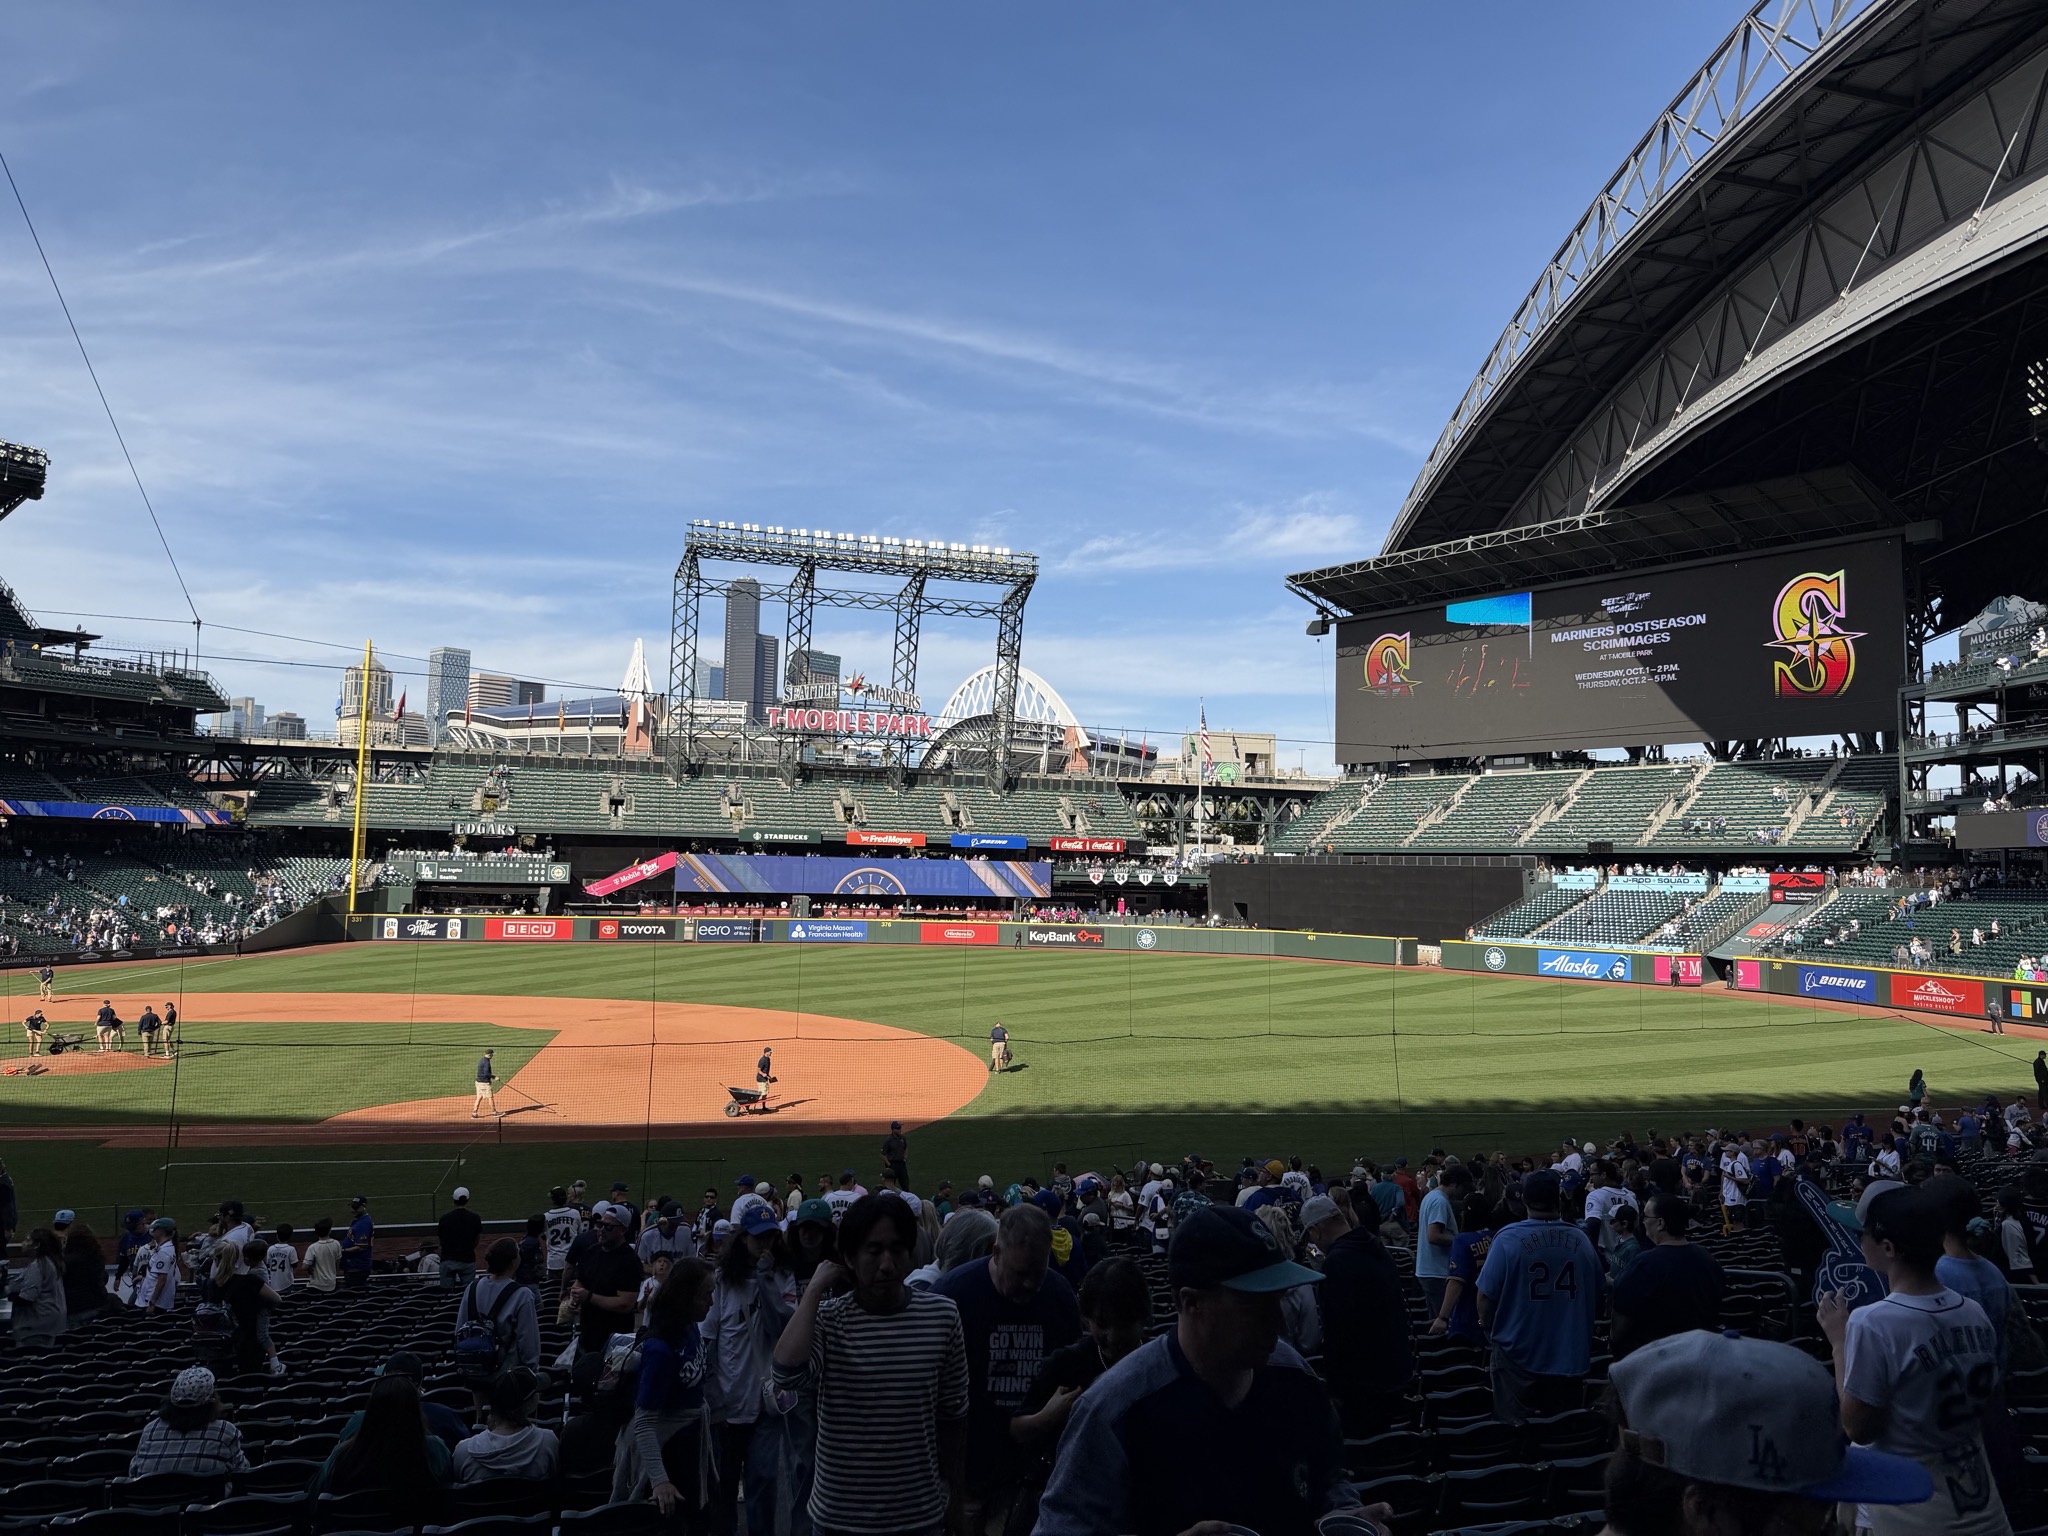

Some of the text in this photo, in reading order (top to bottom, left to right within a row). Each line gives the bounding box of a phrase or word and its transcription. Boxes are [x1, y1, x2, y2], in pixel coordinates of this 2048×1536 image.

[1551, 613, 1706, 643] MARINERS POSTSEASON
[1583, 632, 1671, 652] SCRIMMAGES
[1599, 649, 1653, 661] AT T-MOBILE PARK
[1575, 669, 1626, 681] WEDNESDAY,
[1628, 667, 1645, 676] OCT.
[1657, 665, 1663, 673] 2
[1663, 663, 1680, 672] P.M.
[1578, 679, 1621, 690] THURSDAY,
[1622, 677, 1641, 686] OCT.
[1641, 676, 1647, 684] 2
[1654, 675, 1660, 683] 5
[1660, 673, 1677, 682] P.M.
[784, 684, 837, 702] SEATTLE
[867, 683, 921, 710] MARINERS
[766, 707, 932, 735] T-MOBILE PARK
[870, 835, 912, 845] Fred Meyer
[620, 870, 641, 883] Mobile
[621, 925, 666, 934] TOYOTA
[699, 926, 730, 935] eero
[1029, 931, 1076, 943] KeyBank
[1543, 955, 1599, 976] Alaska
[1819, 976, 1866, 989] BOEING
[1914, 995, 1954, 1005] MUCKLESHOOT
[1922, 1138, 1936, 1151] 44
[548, 1216, 574, 1228] GRIFFEY
[550, 1227, 571, 1245] 24
[1520, 1229, 1582, 1255] GRIFFEY
[271, 1259, 286, 1272] 24
[1528, 1261, 1577, 1302] 24
[997, 1324, 1043, 1332] MIGHT AS WELL
[990, 1332, 1043, 1348] GO WIN
[990, 1349, 1043, 1360] THE WHOLE
[1747, 1424, 1786, 1483] LA
